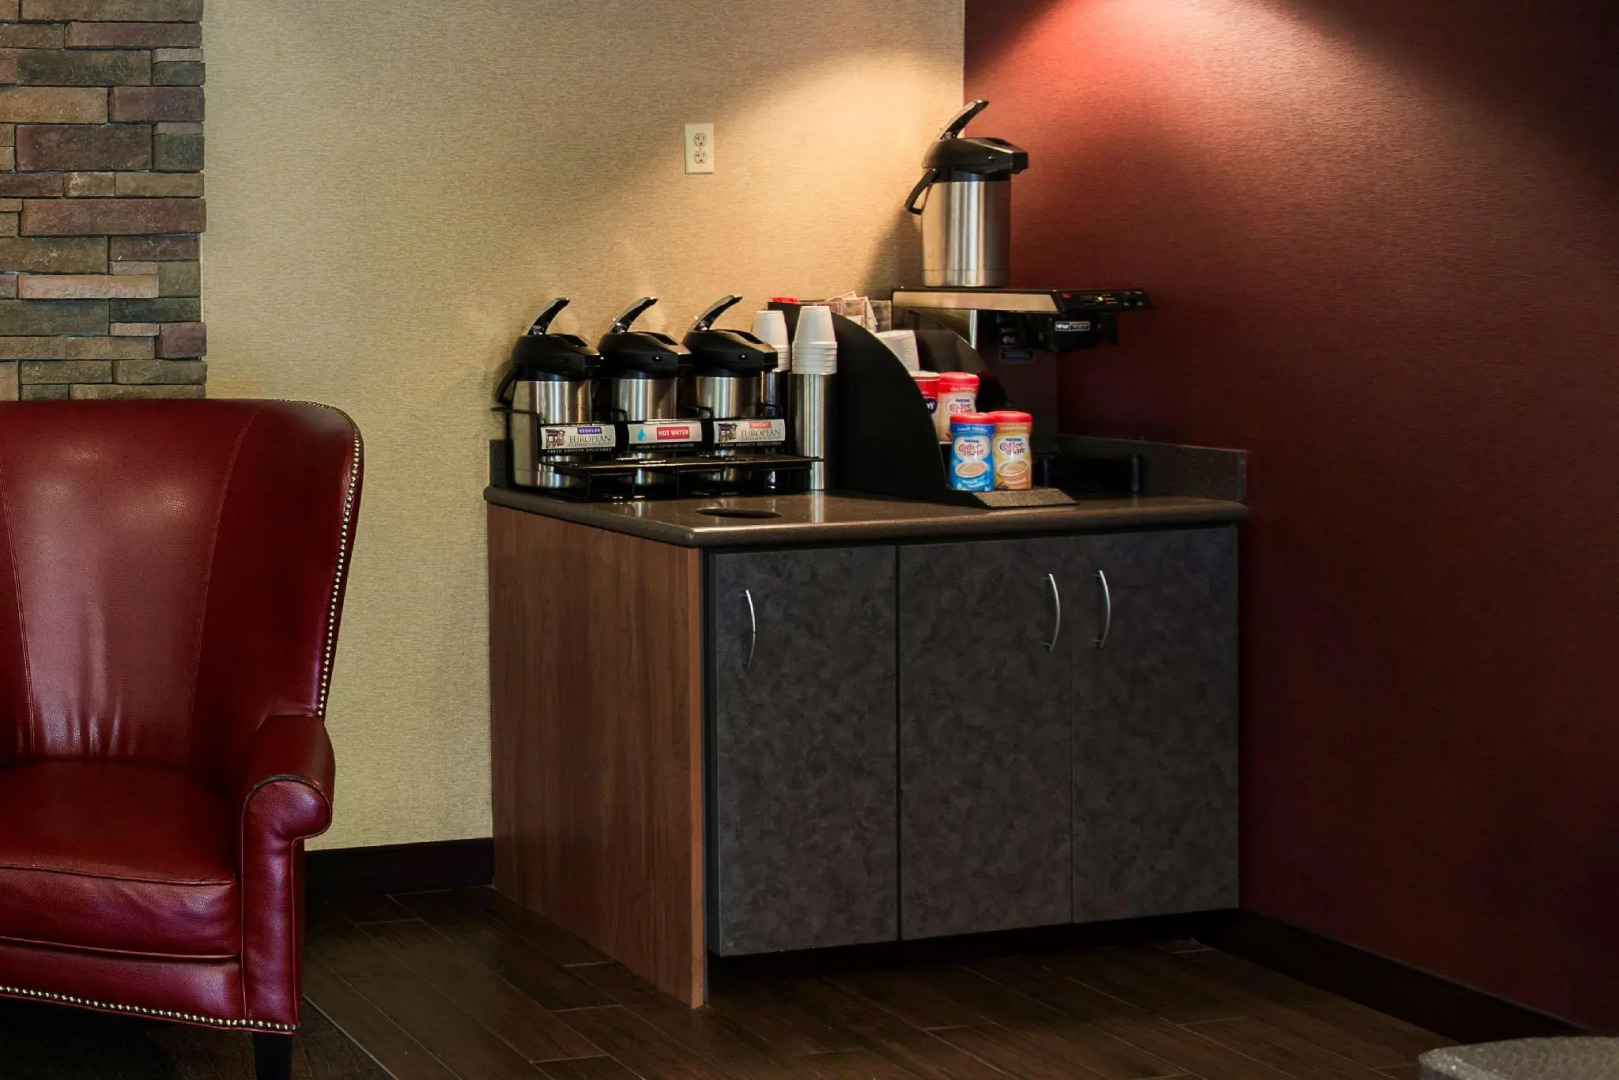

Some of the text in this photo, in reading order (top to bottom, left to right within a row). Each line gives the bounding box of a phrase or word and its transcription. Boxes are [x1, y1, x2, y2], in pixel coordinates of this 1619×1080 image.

[658, 428, 689, 437] HOT WATER
[741, 429, 781, 437] EUROPEAN
[569, 435, 611, 443] EUROPEAN
